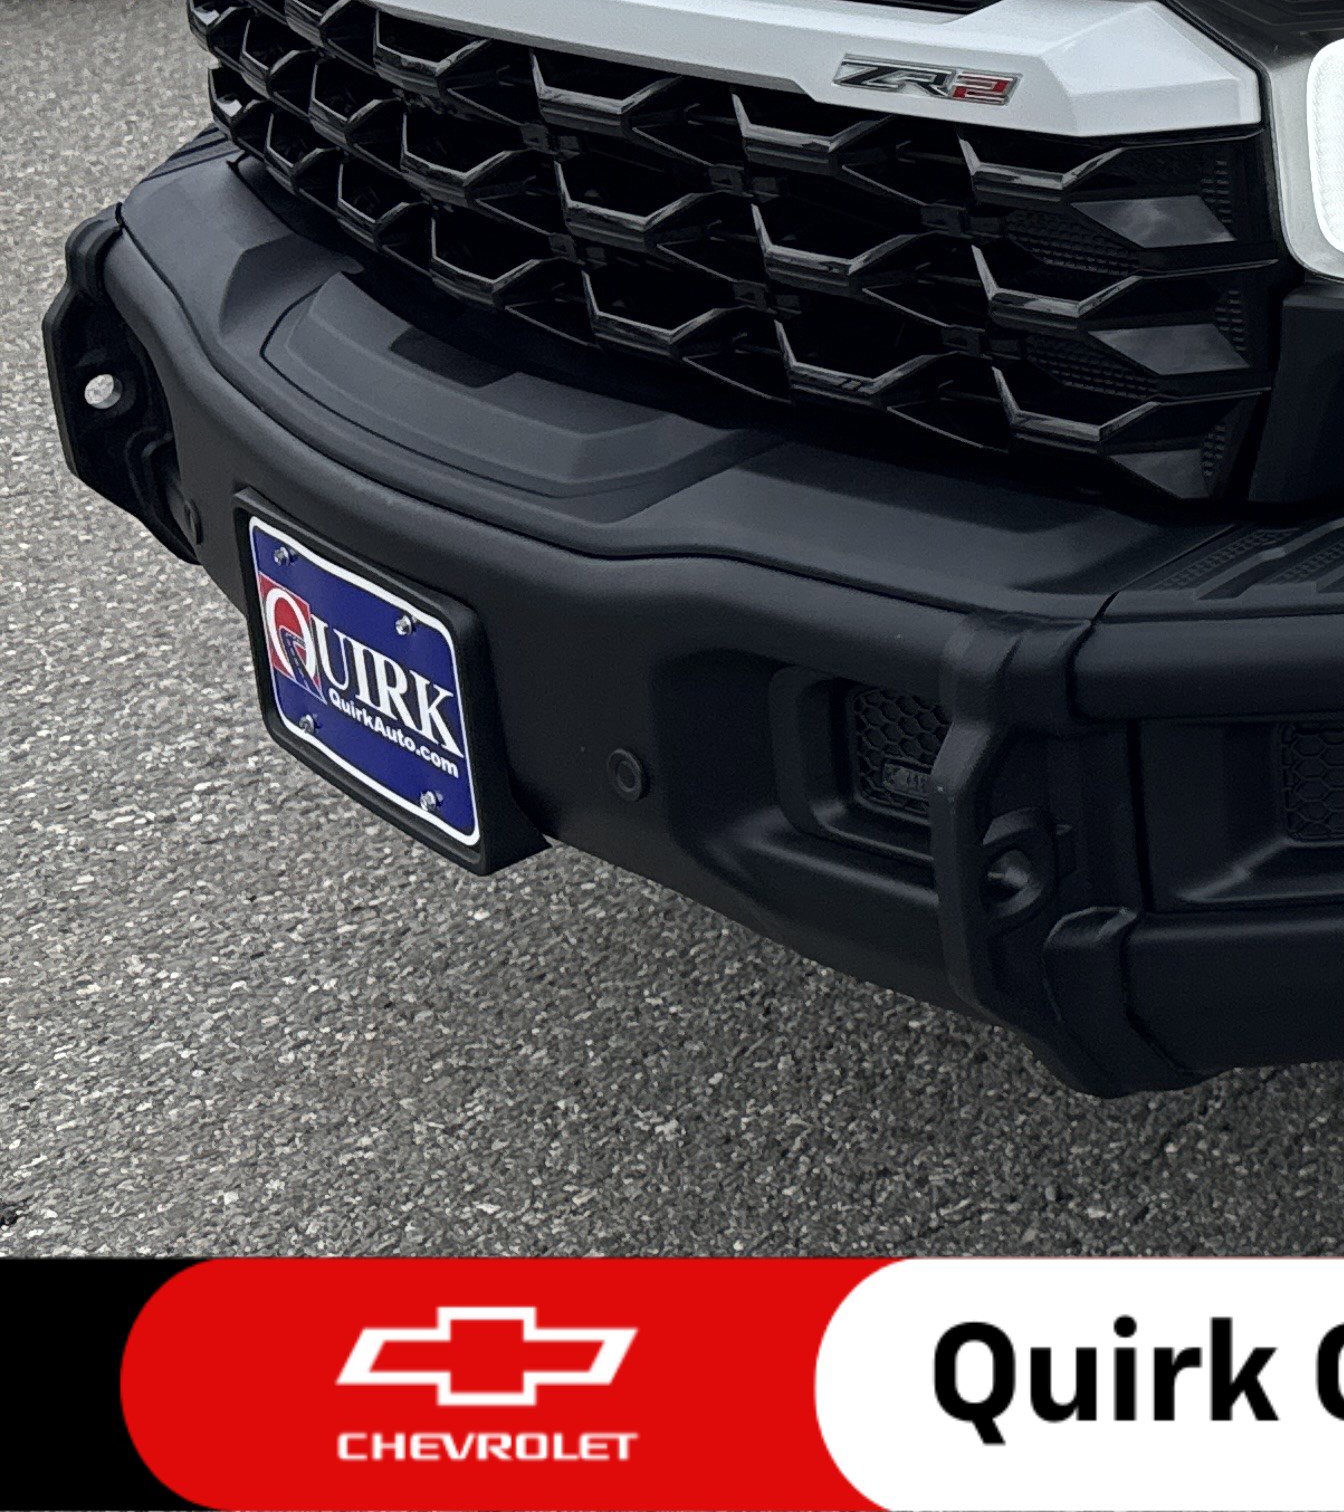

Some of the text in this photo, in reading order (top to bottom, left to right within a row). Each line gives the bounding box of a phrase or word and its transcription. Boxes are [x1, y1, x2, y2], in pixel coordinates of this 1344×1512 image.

[833, 52, 1023, 106] ZR2
[265, 587, 464, 758] QUIRK
[328, 687, 459, 778] QuirkAuto.com
